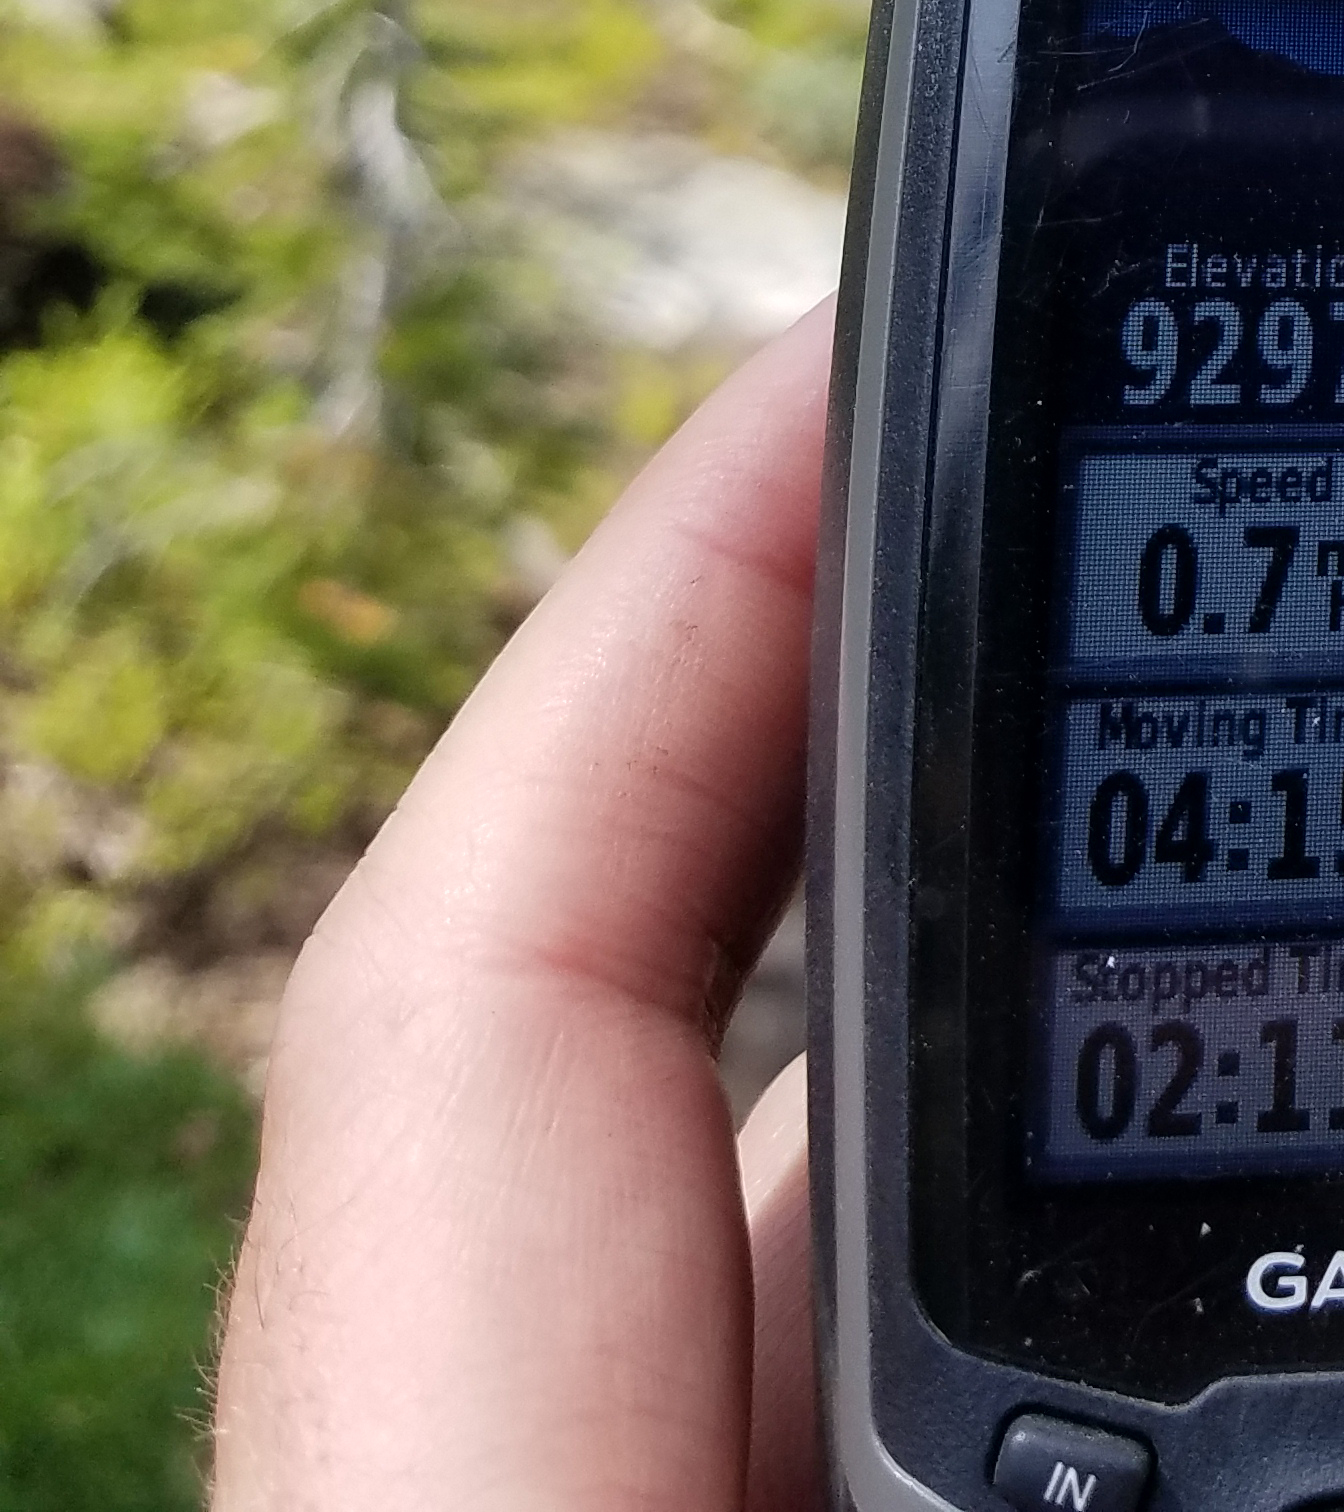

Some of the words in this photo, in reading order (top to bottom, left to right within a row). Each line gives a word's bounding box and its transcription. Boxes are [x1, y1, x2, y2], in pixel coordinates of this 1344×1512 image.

[1195, 455, 1333, 519] Speed
[1137, 522, 1302, 637] 0.7
[1099, 696, 1268, 762] Moving
[1074, 946, 1271, 1015] Stopped
[1043, 1460, 1098, 1512] IN
